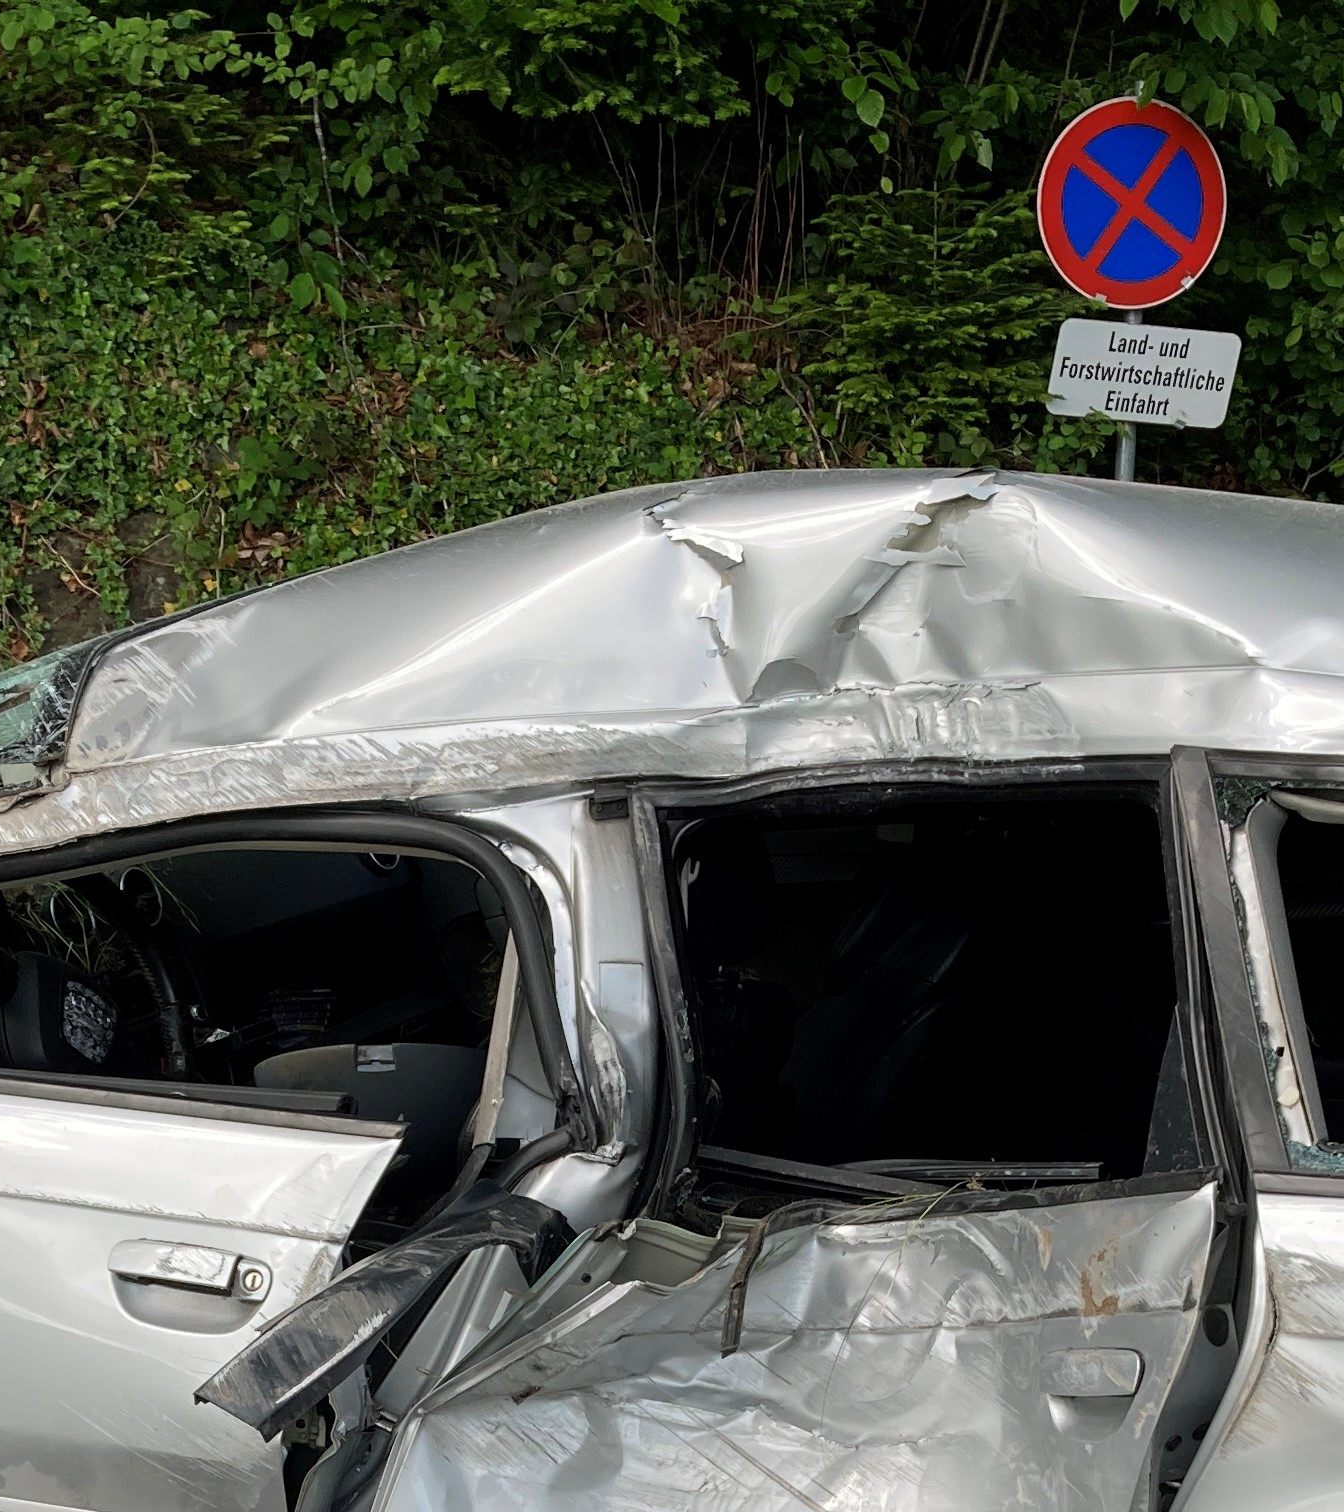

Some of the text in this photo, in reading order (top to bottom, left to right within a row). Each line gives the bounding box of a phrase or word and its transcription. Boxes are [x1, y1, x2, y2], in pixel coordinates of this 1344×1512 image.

[1109, 331, 1190, 358] Land- und
[1059, 357, 1225, 392] Forstwirtschaftliche
[1105, 391, 1169, 416] Einfahrt
